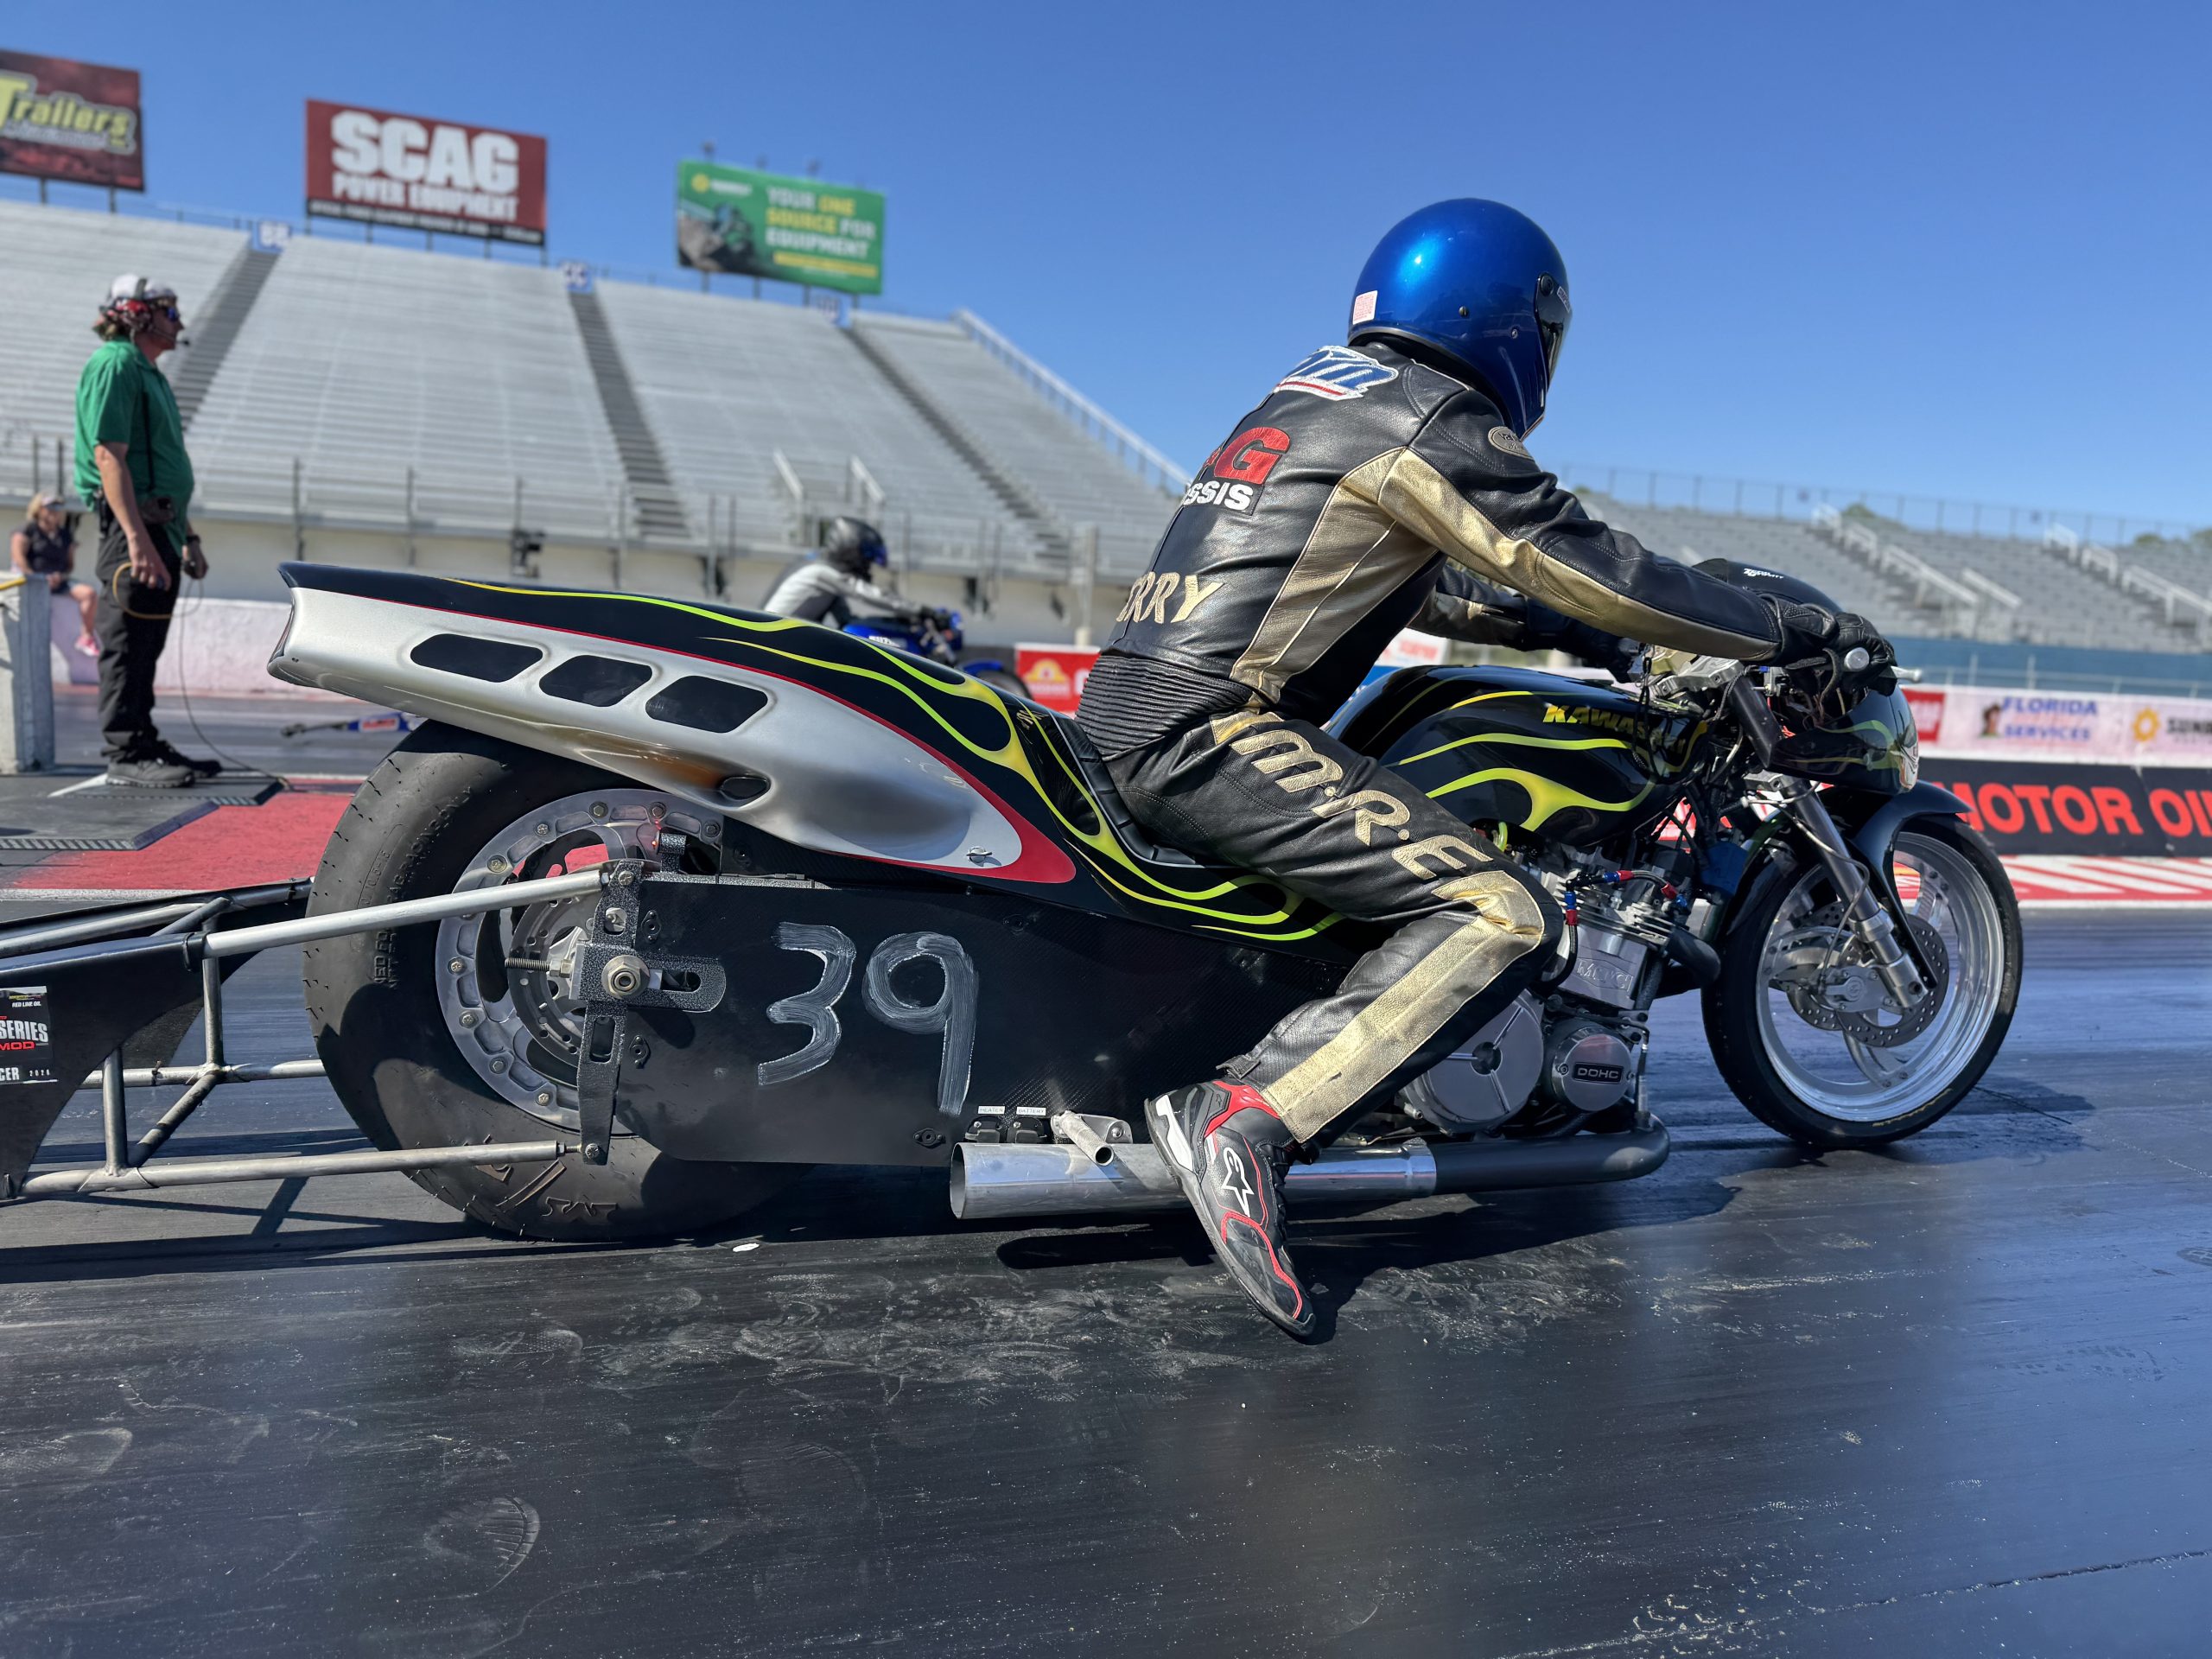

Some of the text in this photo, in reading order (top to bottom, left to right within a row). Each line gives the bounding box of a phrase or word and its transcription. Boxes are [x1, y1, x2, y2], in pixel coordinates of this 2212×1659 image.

[332, 110, 518, 194] SCAG
[333, 172, 406, 208] POWER
[408, 184, 518, 222] EQUIPMENT
[766, 186, 815, 211] YOUR
[820, 195, 855, 216] ONE
[766, 207, 875, 238] SOURCE FOR
[766, 227, 868, 257] EQUIPMENT
[2003, 696, 2097, 715] FLORIDA
[2004, 725, 2090, 741] SERVICES
[0, 1020, 48, 1043] SERIES
[757, 921, 979, 1116] 39
[1577, 1066, 1619, 1080] DOHC
